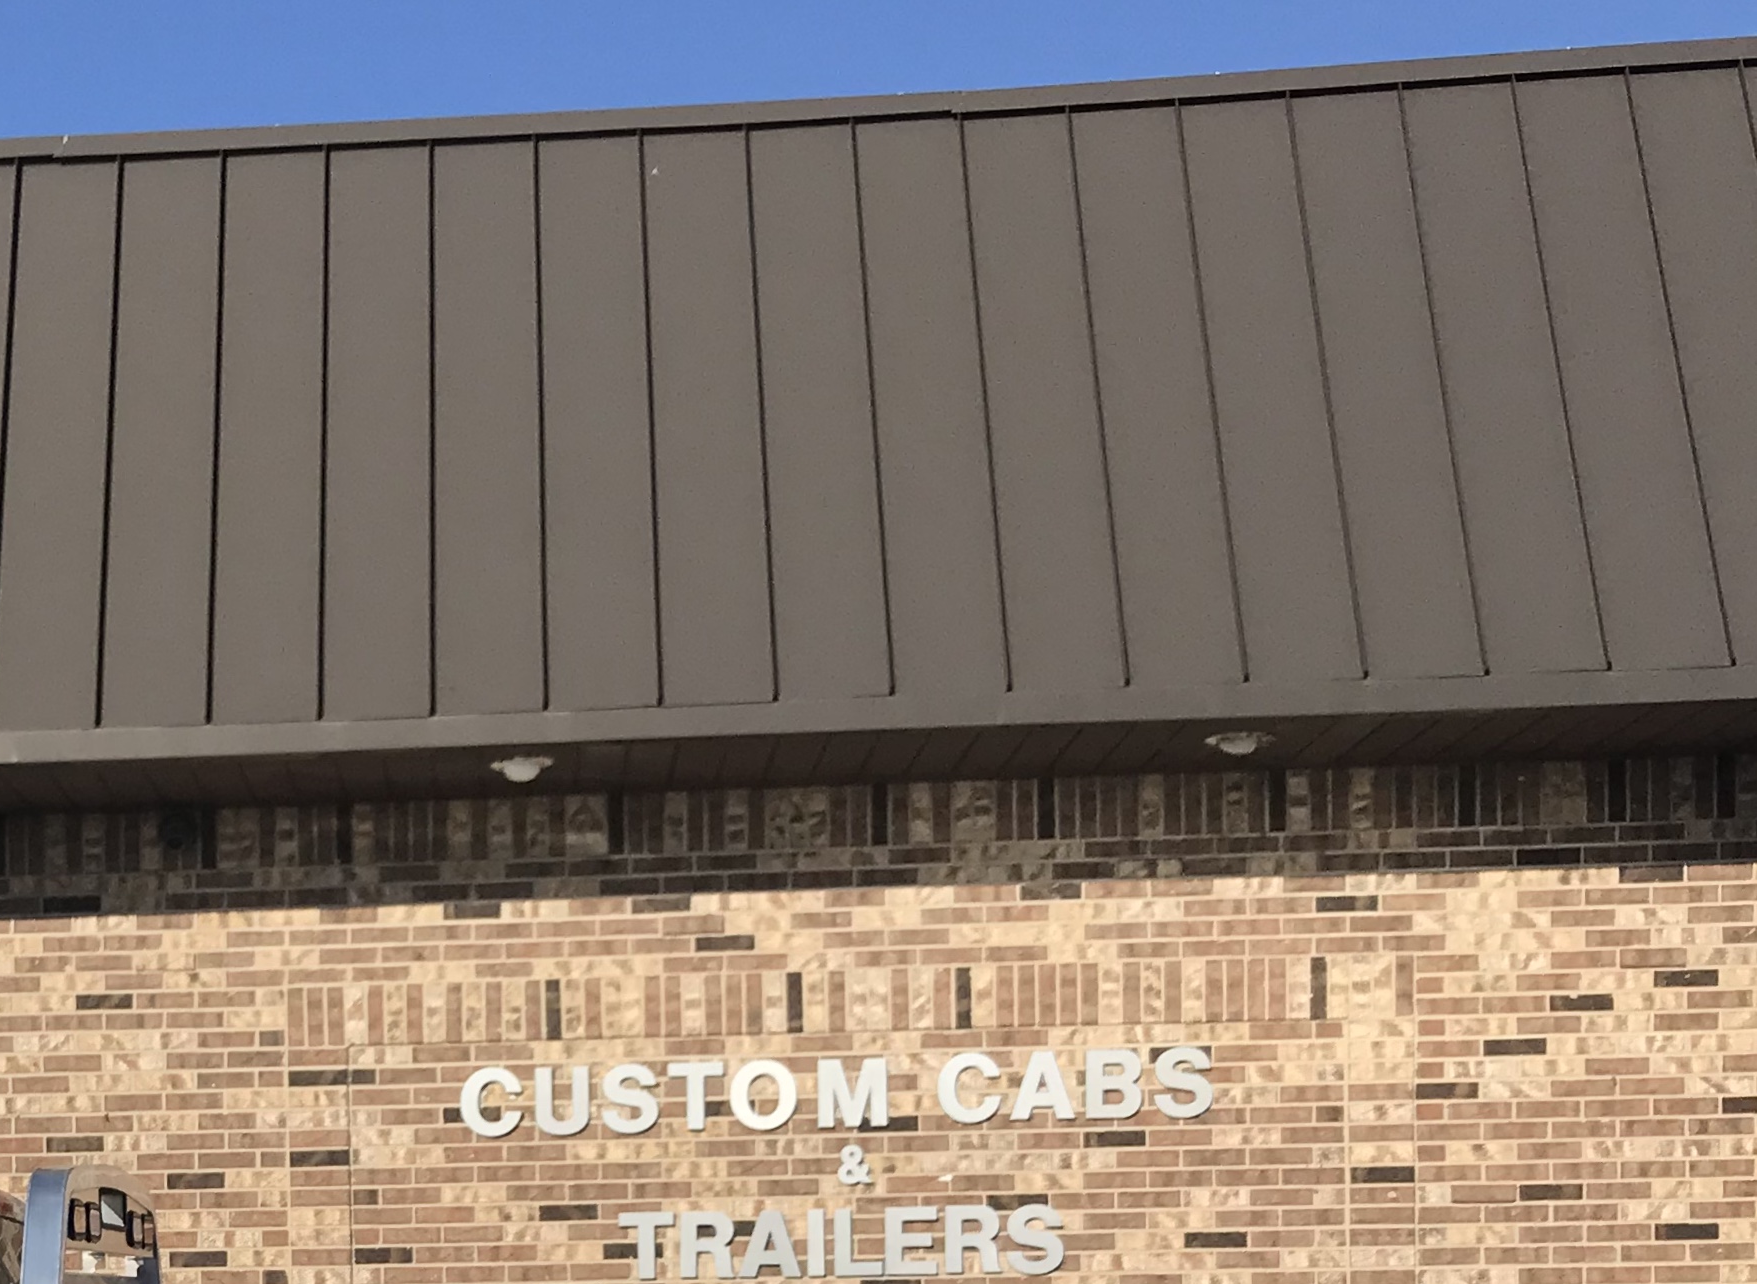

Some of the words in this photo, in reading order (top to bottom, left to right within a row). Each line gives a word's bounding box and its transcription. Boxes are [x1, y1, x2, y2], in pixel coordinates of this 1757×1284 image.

[460, 1058, 890, 1137] CUSTOM
[937, 1046, 1215, 1125] CABS
[837, 1144, 873, 1186] &
[618, 1204, 1066, 1280] TRAILERS
